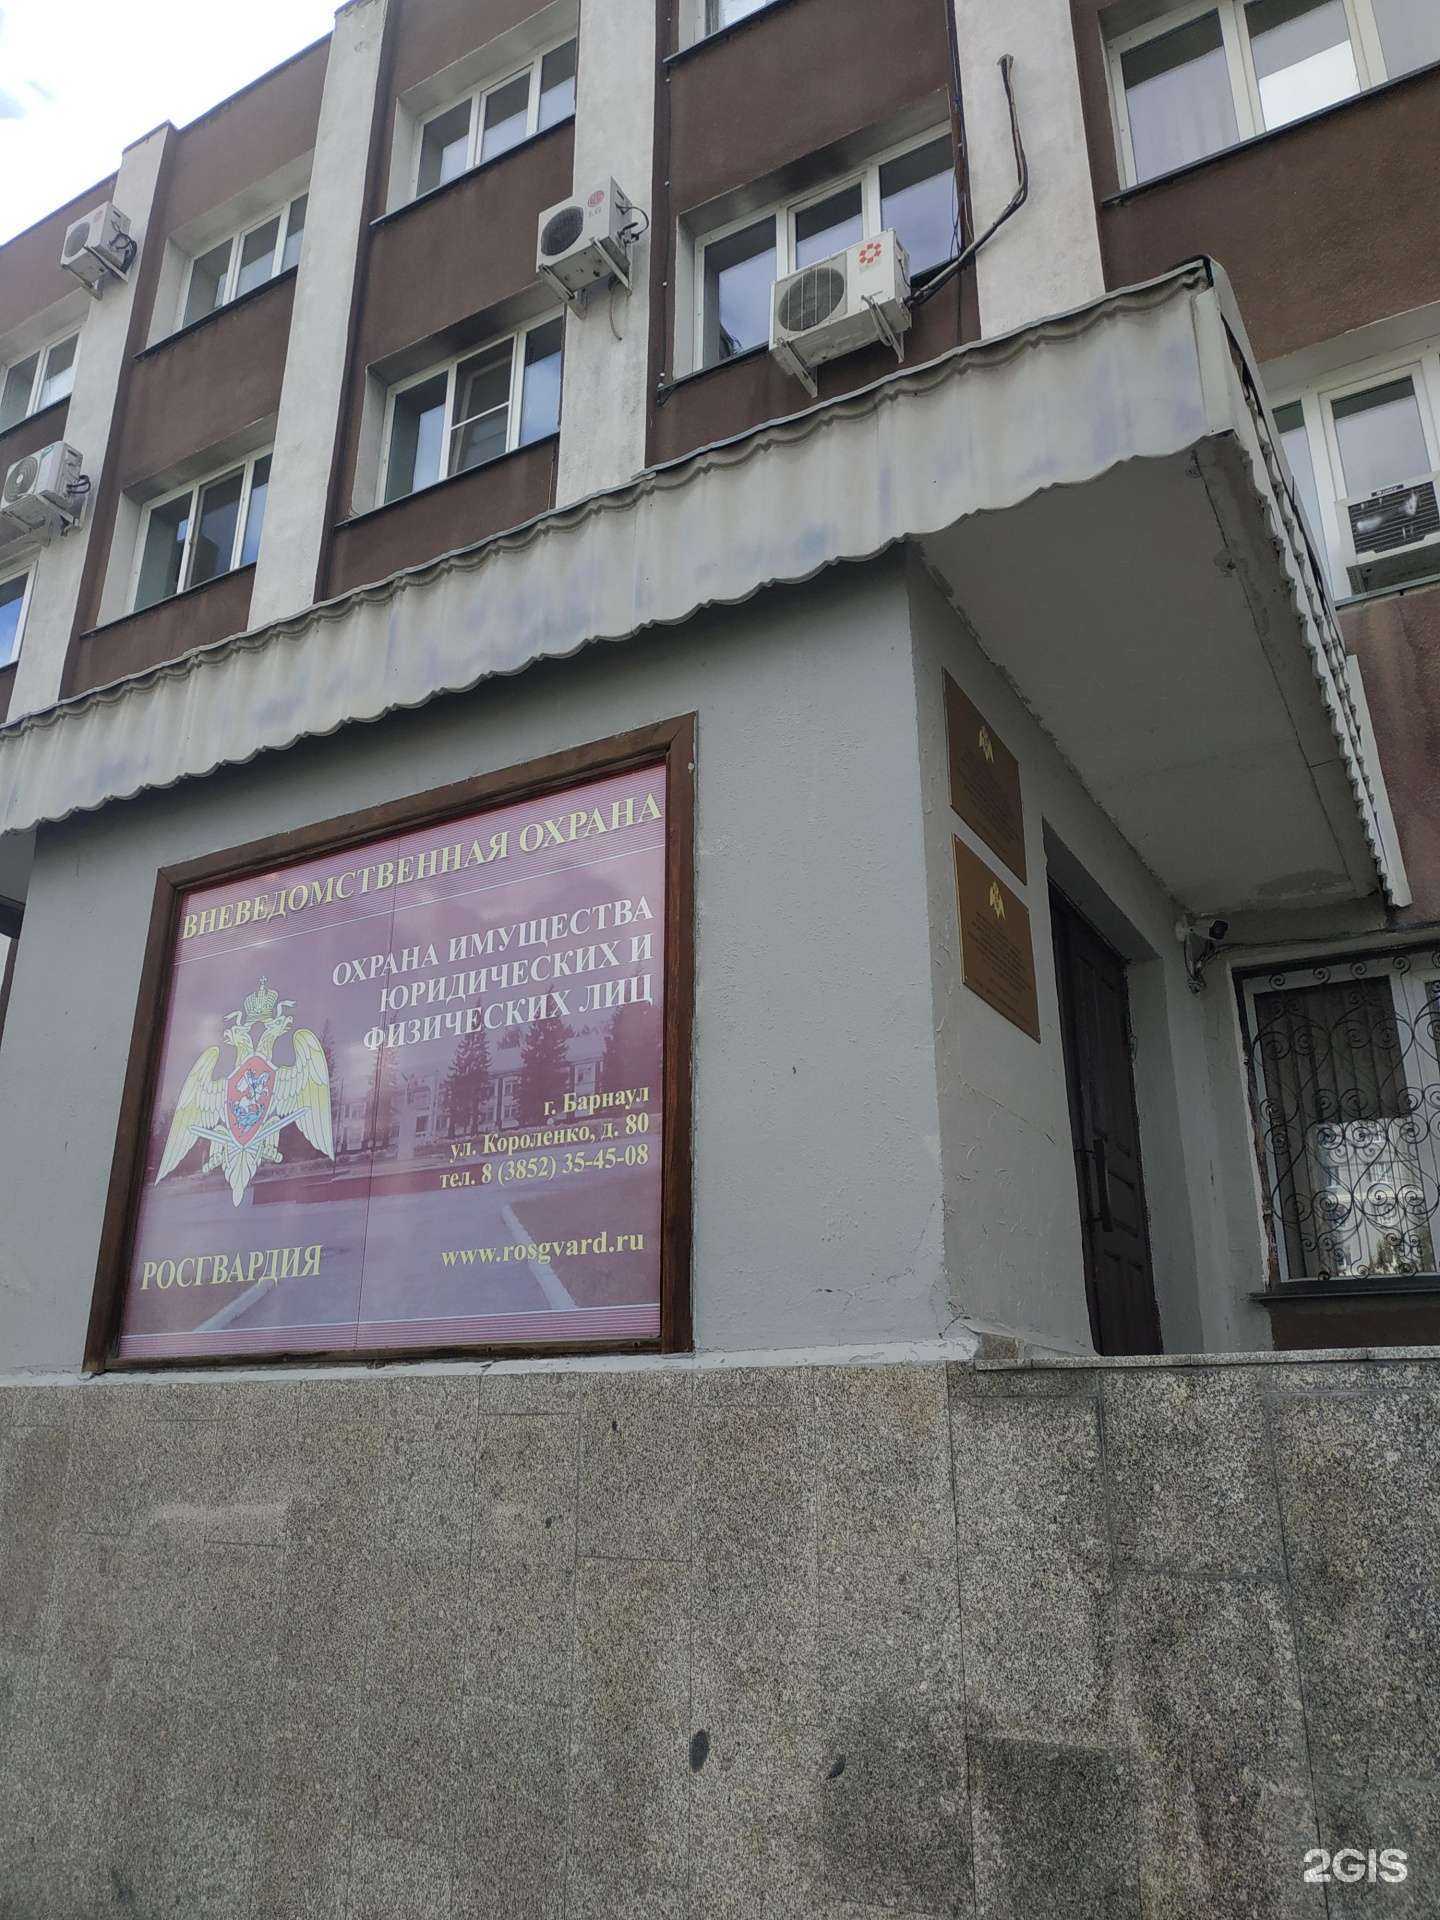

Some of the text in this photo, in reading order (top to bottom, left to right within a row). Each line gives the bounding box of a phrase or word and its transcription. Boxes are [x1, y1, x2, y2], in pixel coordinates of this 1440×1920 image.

[182, 793, 662, 939] ВНЕВЕДОМСТВЕННАЯ ОХРАНА
[332, 896, 654, 986] ОХРАНА ИМУЩЕСТВА
[379, 933, 654, 1012] ЮРИДИЧЕСКИХ И
[363, 973, 655, 1050] ФИЗИЧЕСКИХ ЛИЦ
[544, 1087, 649, 1116] г. Барнаул
[450, 1112, 649, 1163] ул. Короленко, д. 80
[440, 1144, 649, 1189] тел. 8 (3852) 35-45-08
[140, 1244, 323, 1290] РОСГВАРДИЯ
[441, 1231, 645, 1267] www.rosgvard.ru
